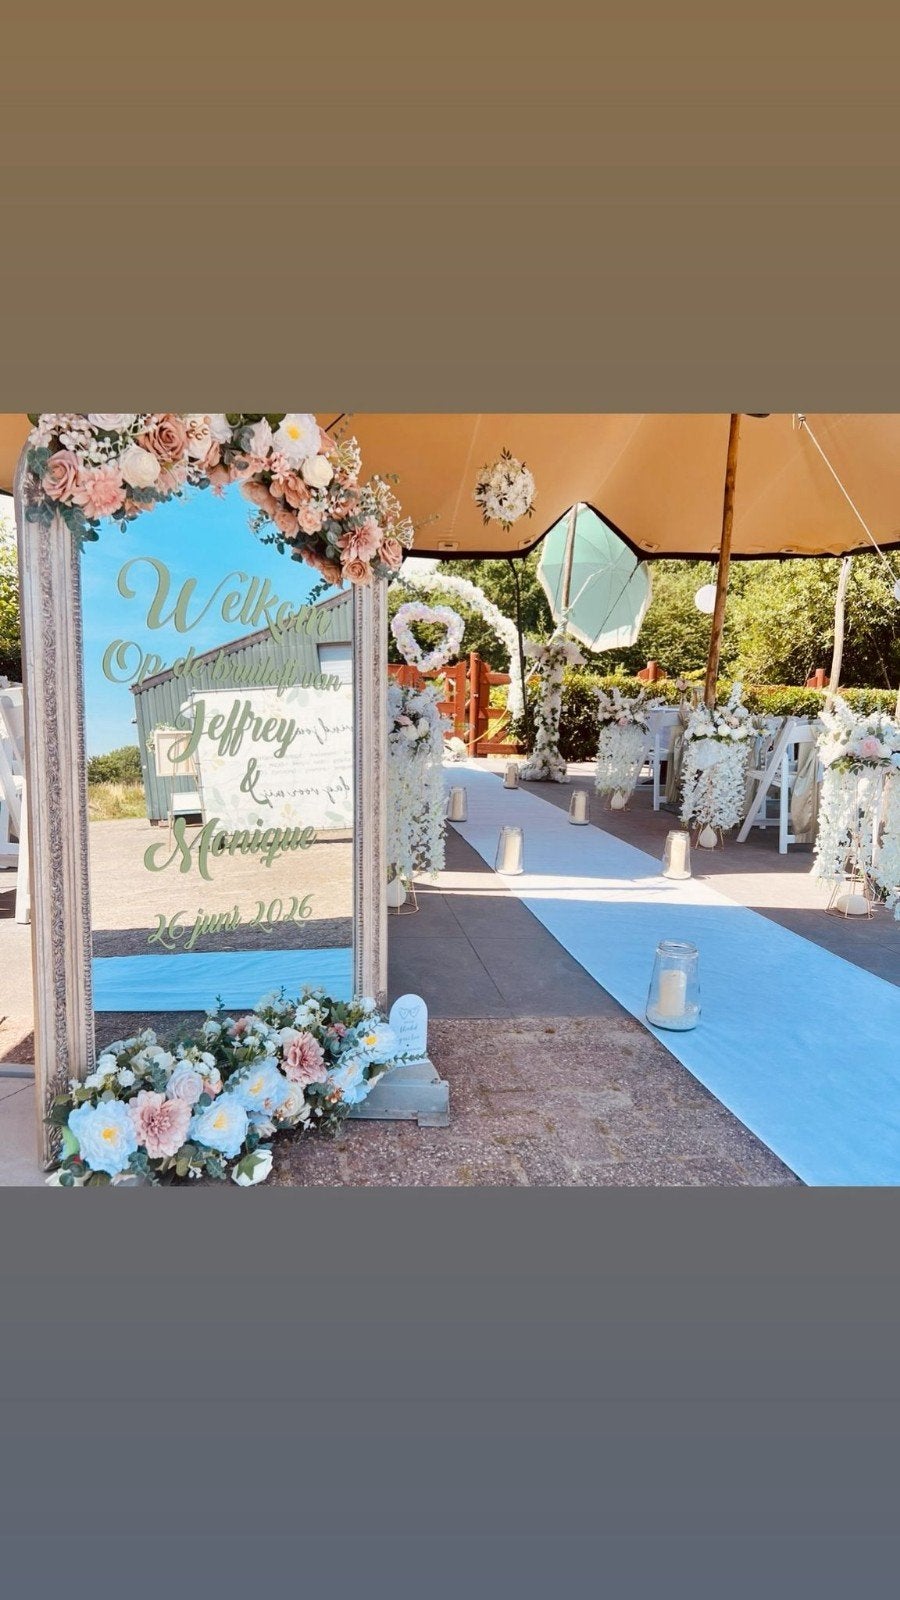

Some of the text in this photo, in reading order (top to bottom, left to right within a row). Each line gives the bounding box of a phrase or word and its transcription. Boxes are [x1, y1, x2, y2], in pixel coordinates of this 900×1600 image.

[118, 557, 332, 644] Welkom
[102, 639, 343, 697] Op de bruiloft van
[167, 699, 299, 763] Jeffrey
[240, 757, 269, 804] &
[144, 817, 317, 881] Monique
[147, 894, 315, 950] 26 juni 2026
